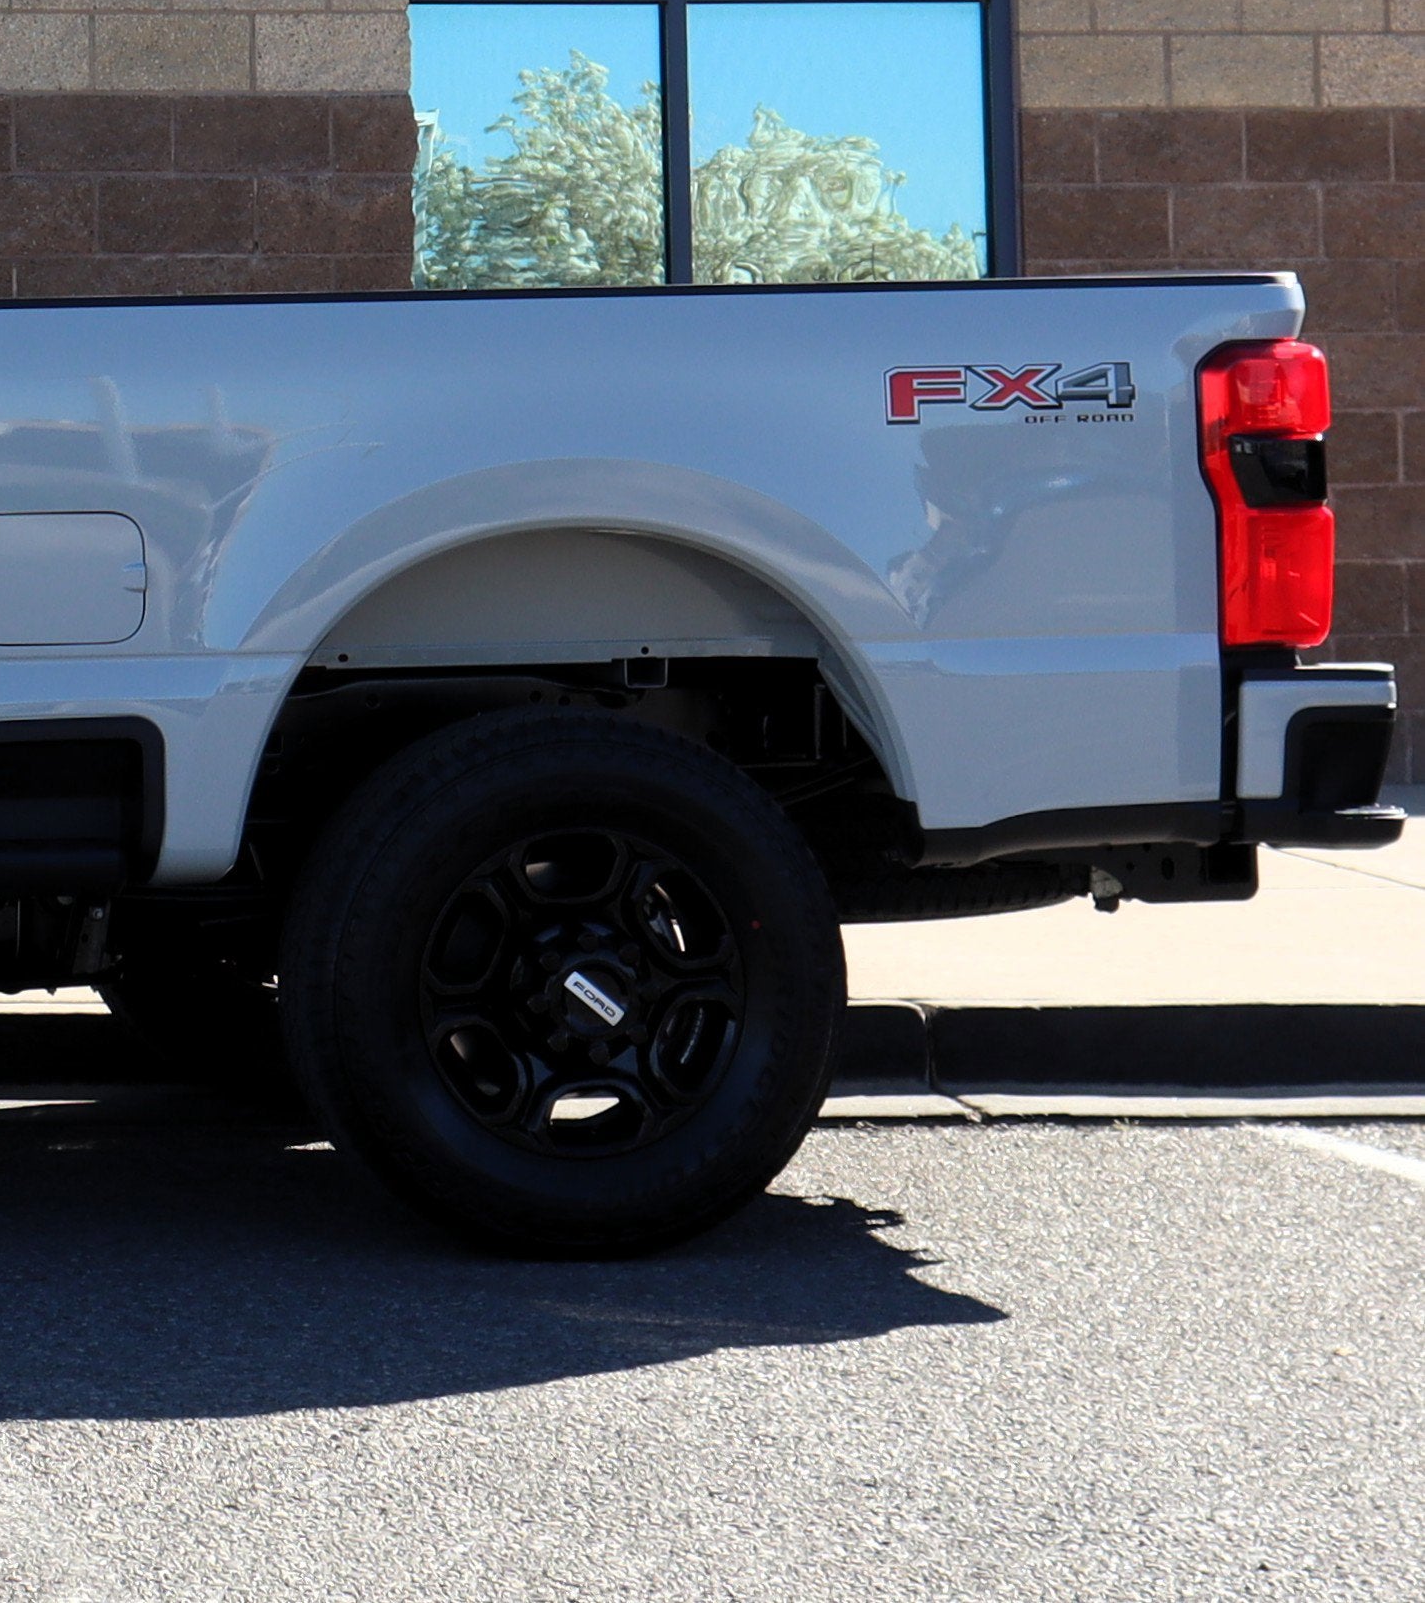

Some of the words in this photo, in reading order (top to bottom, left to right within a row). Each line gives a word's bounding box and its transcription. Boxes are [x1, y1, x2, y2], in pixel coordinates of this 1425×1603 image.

[884, 362, 1135, 425] FX4
[1025, 415, 1068, 424] OFF
[1077, 414, 1134, 423] ROAD
[573, 981, 616, 1017] FORD
